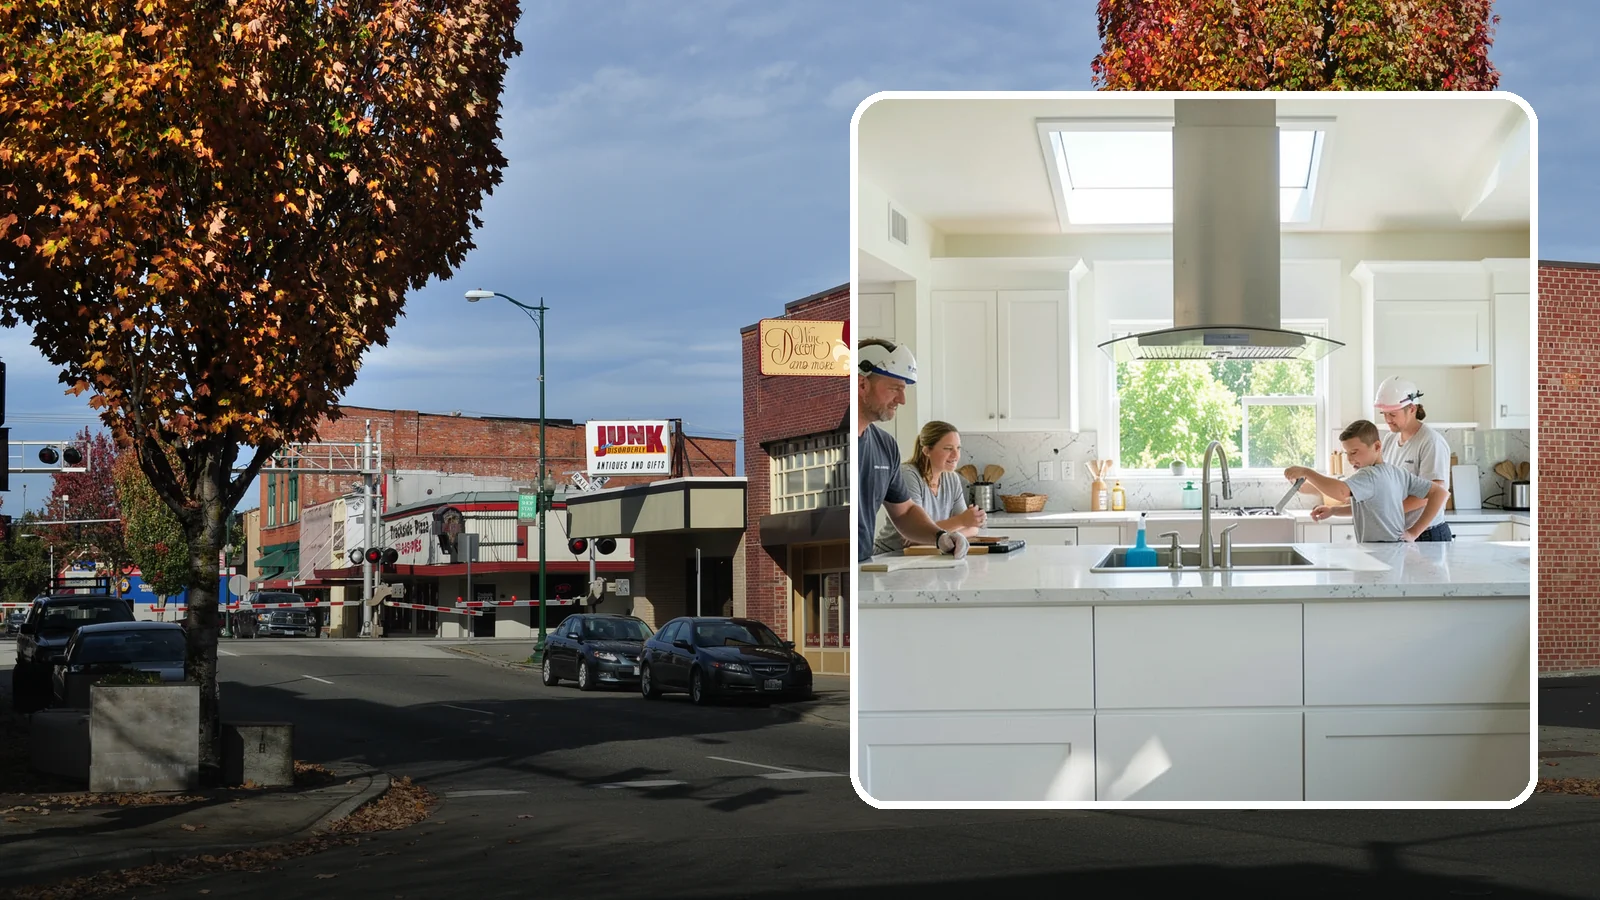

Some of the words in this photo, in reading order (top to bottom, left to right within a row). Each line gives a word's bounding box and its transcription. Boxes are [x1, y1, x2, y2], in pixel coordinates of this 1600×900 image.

[595, 425, 665, 457] JUNK
[607, 446, 646, 454] DISORDERLY
[597, 461, 628, 470] ANTIQUES
[631, 461, 644, 470] AND
[647, 460, 666, 470] GIFTS
[390, 521, 413, 539] Trackside
[414, 519, 429, 535] Pizza
